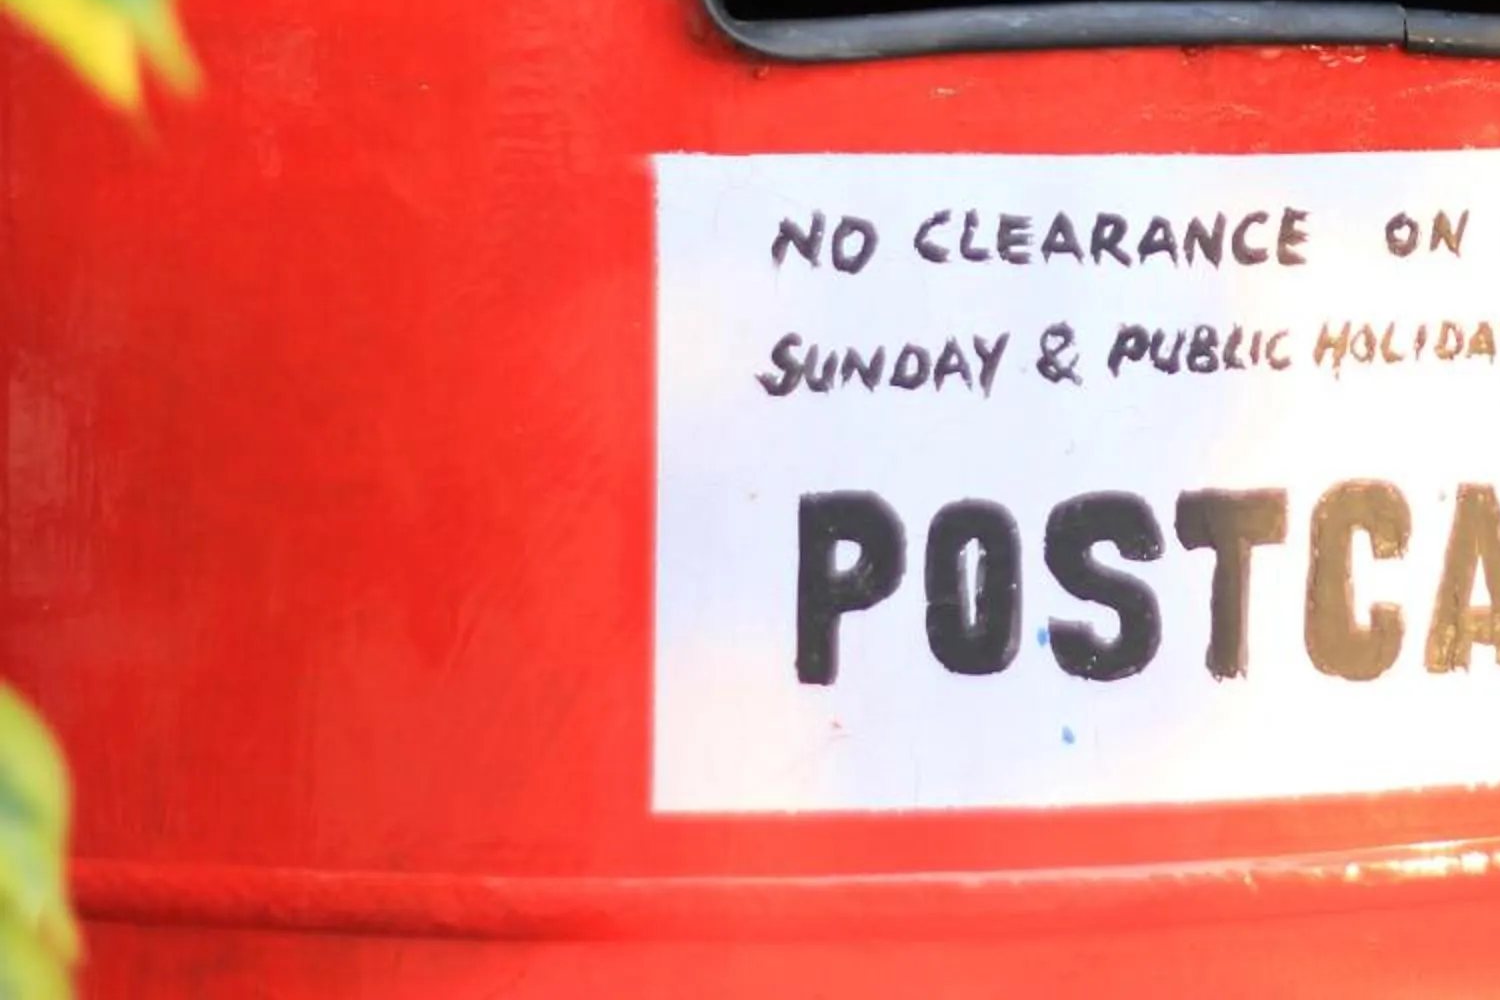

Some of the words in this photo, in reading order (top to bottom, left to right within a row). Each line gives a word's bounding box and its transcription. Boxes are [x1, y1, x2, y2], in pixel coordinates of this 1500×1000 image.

[770, 211, 879, 275] NO
[912, 206, 1309, 269] CLEARANCE
[1384, 210, 1470, 260] ON
[756, 331, 1010, 398] SUNDAY
[1034, 321, 1082, 385] &
[1106, 322, 1291, 379] PUBLIC
